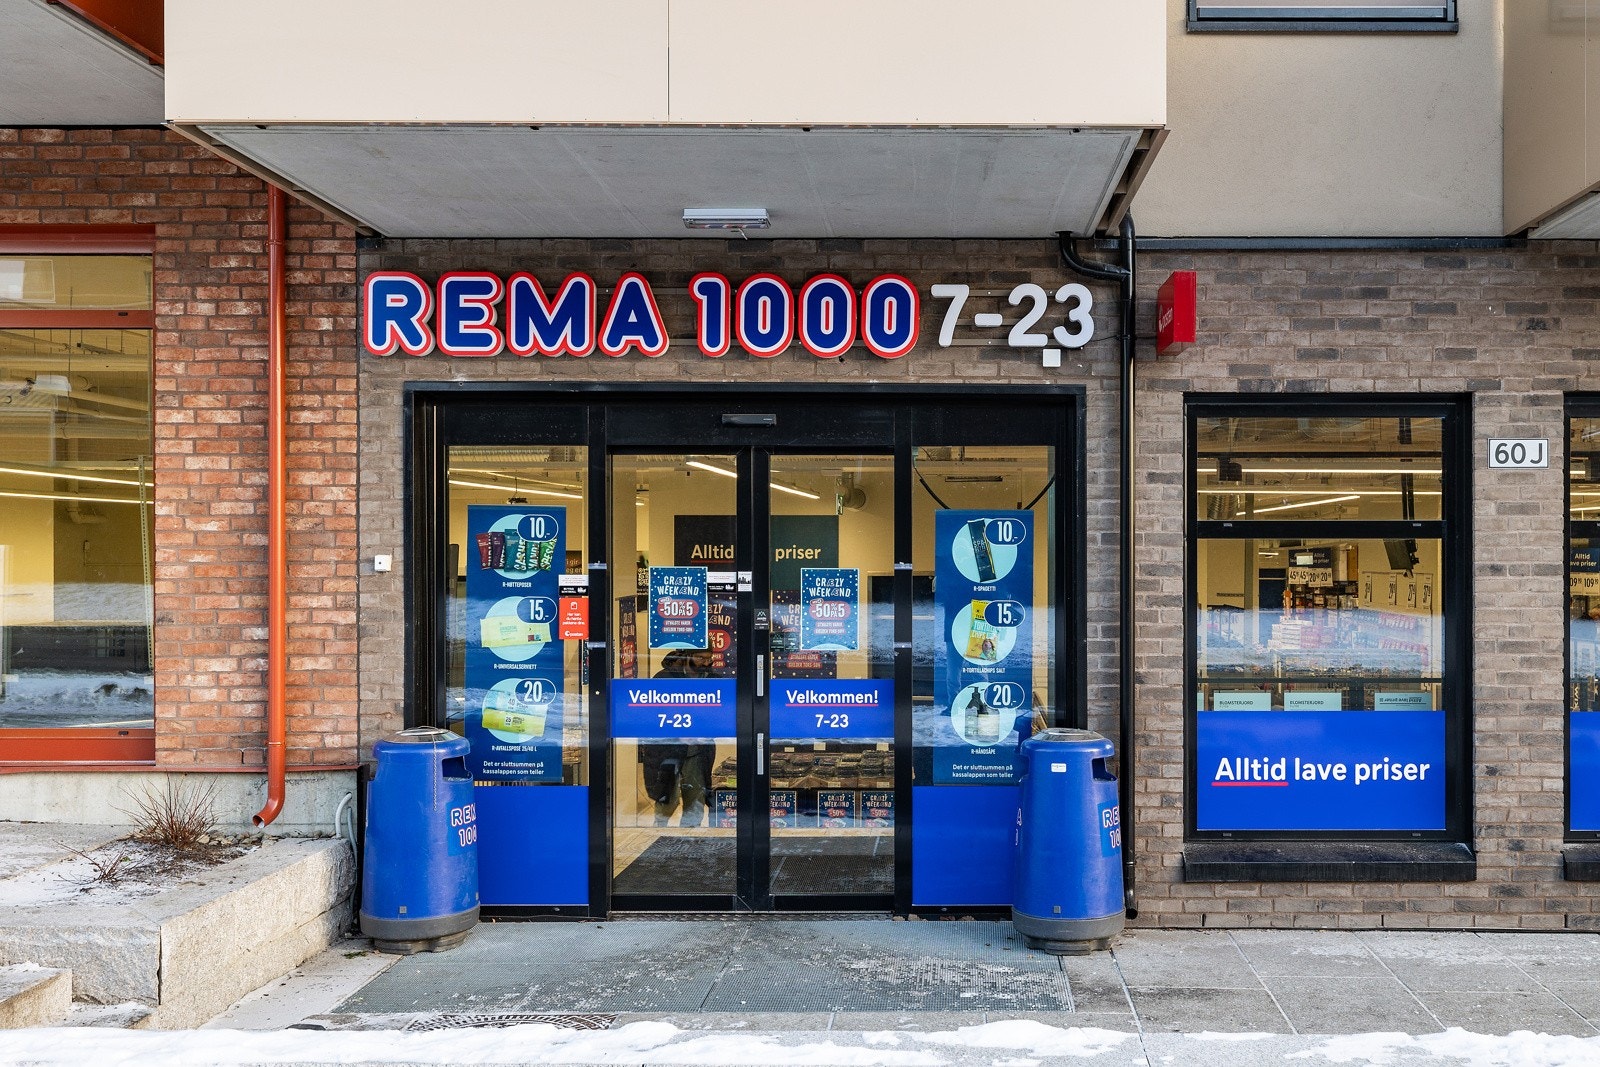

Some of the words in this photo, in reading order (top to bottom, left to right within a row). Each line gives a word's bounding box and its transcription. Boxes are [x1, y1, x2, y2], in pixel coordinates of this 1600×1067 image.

[364, 271, 670, 358] REMA
[689, 272, 922, 360] 1000
[931, 283, 1095, 349] 7-23
[1495, 443, 1526, 464] 60
[1530, 443, 1542, 464] J
[691, 545, 735, 559] Alltid
[775, 544, 822, 562] priser
[686, 602, 693, 616] 5
[838, 603, 845, 618] 5
[628, 689, 722, 704] Velkommen!
[786, 689, 879, 704] Velkommen!
[658, 713, 692, 728] 7-23
[815, 713, 849, 728] 7-23
[482, 768, 517, 776] kassalappen
[536, 760, 544, 769] på
[1215, 757, 1287, 781] Alltid
[1293, 757, 1347, 781] lave
[1354, 757, 1431, 786] priser
